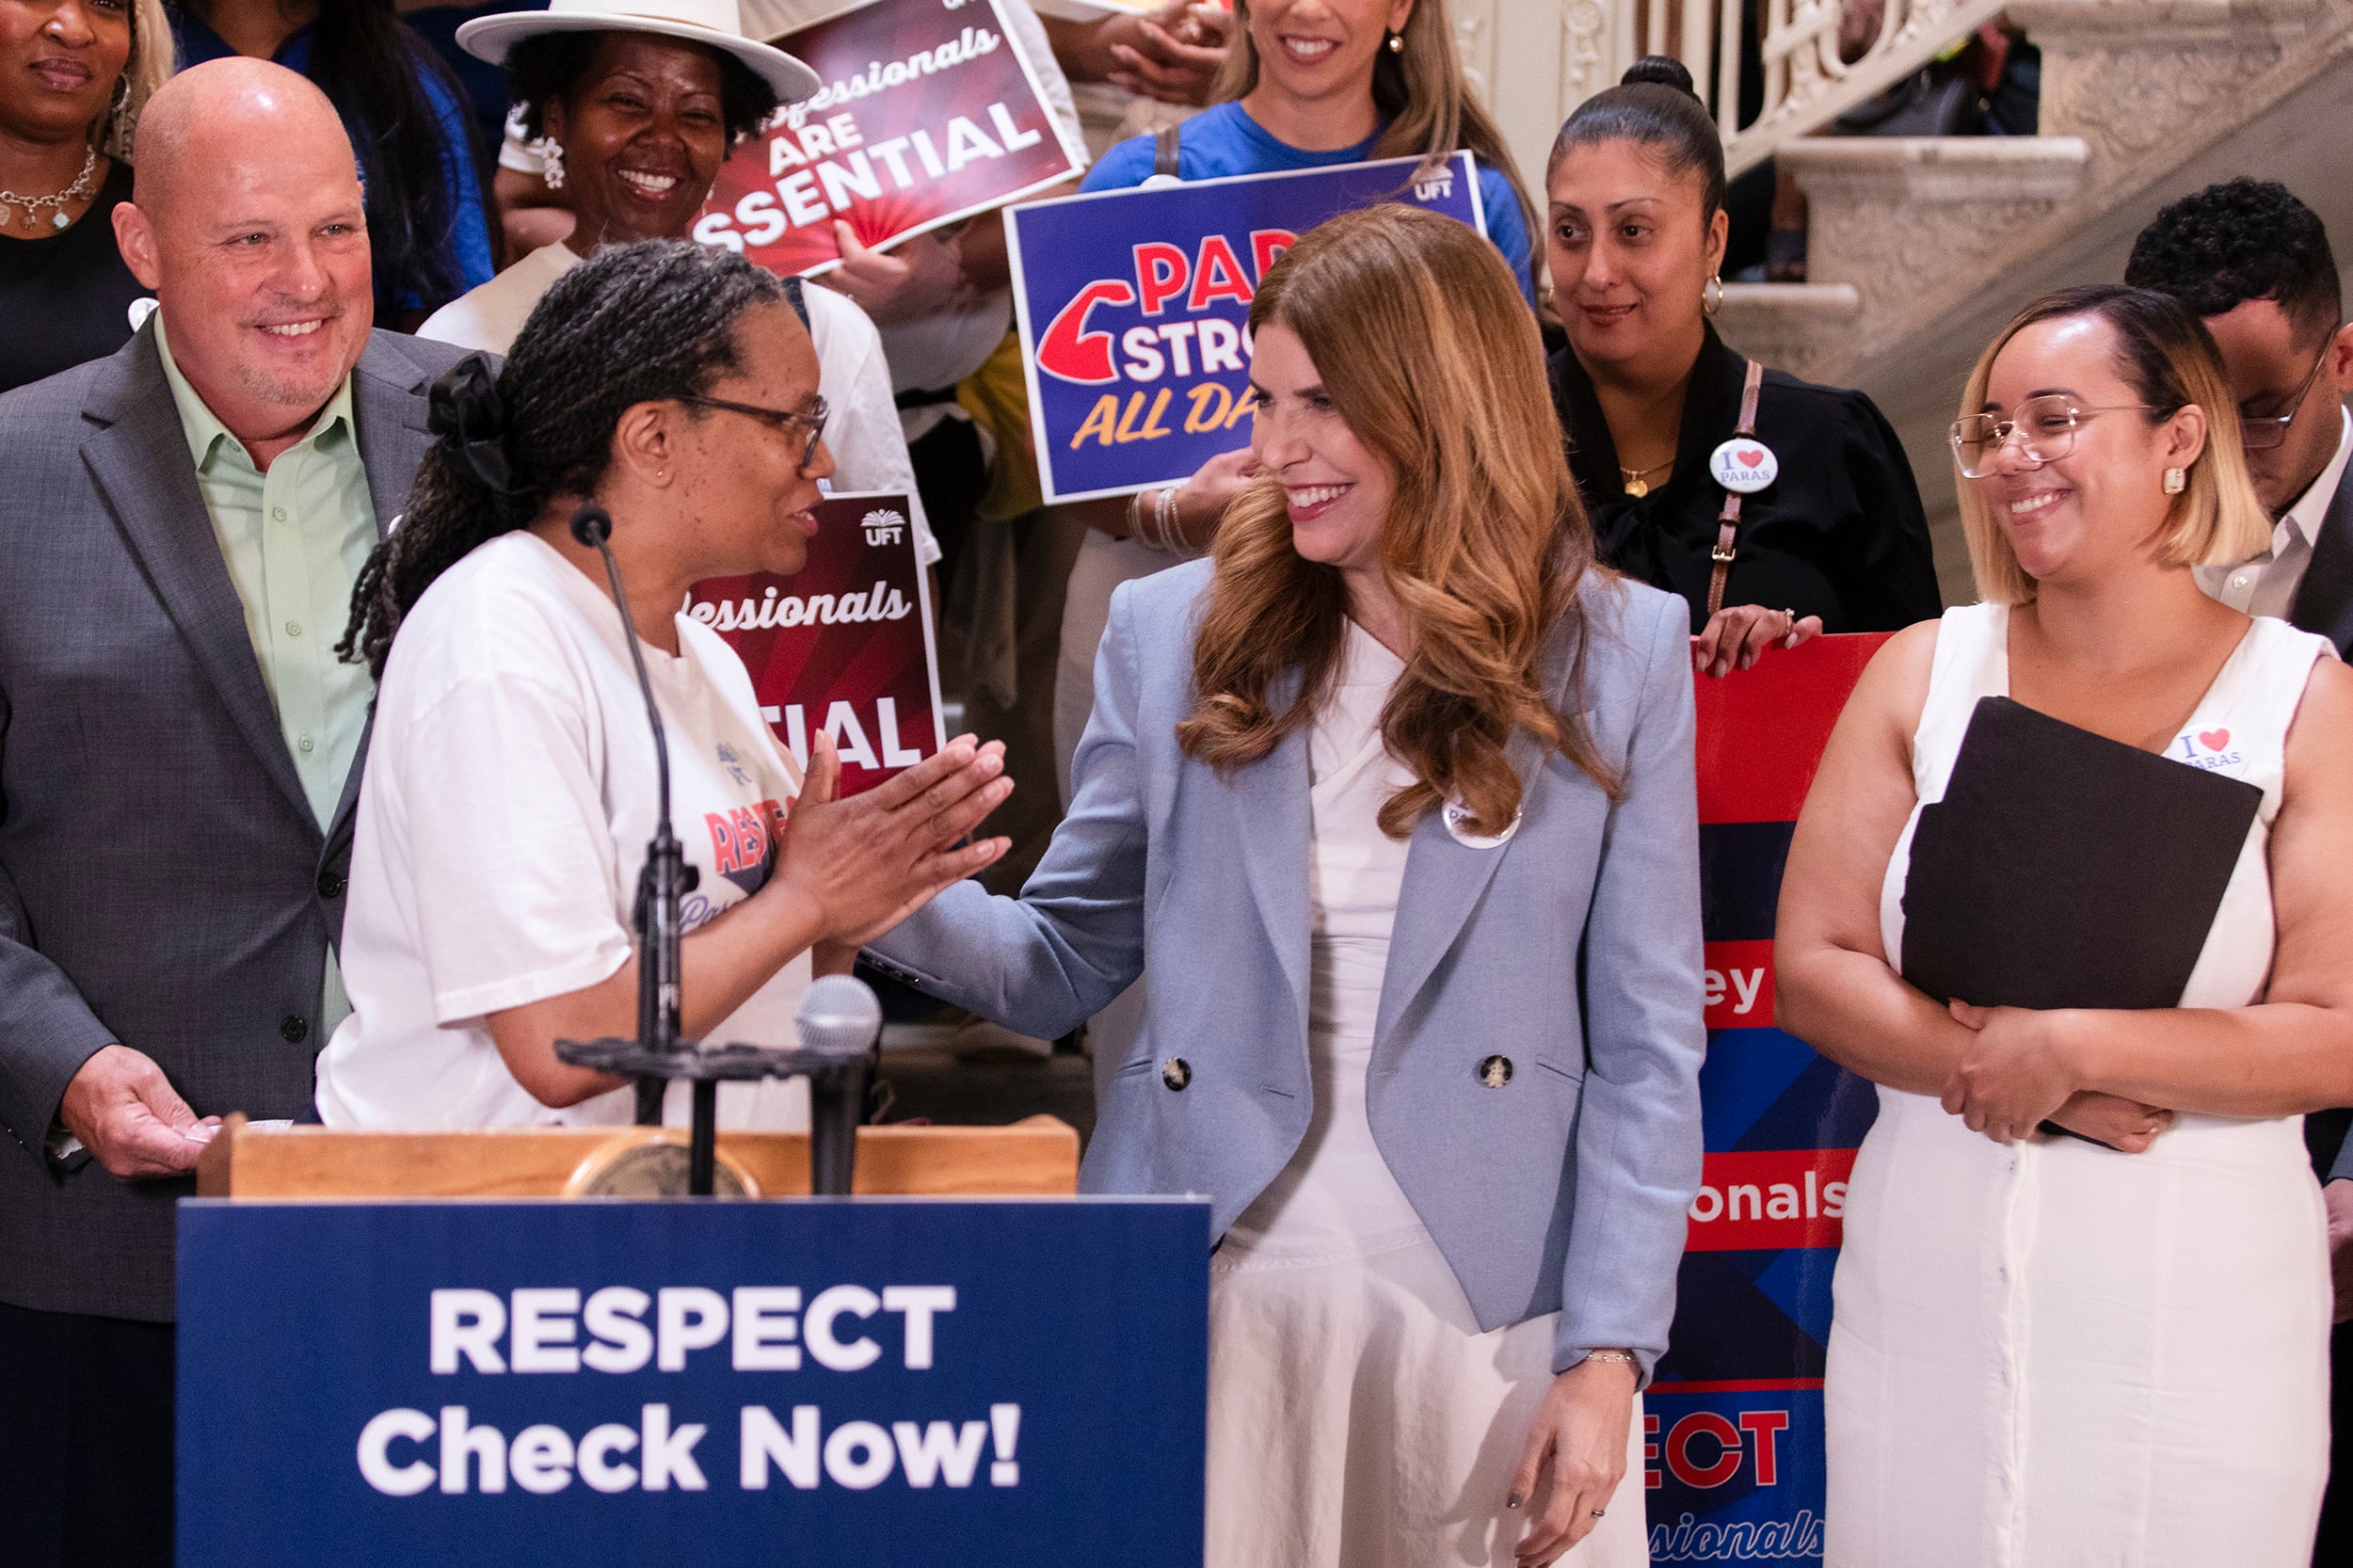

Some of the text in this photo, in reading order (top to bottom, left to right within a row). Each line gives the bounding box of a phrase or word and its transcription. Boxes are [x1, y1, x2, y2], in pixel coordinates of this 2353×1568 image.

[769, 112, 864, 177] ARE
[692, 102, 1042, 252] SSENTIAL
[1122, 318, 1255, 382] STR
[1070, 387, 1173, 450] ALL
[1721, 470, 1770, 483] PARAS
[1723, 451, 1734, 470] I
[865, 527, 903, 546] UFT
[680, 581, 912, 632] essionals
[2179, 734, 2198, 758] I
[1689, 1170, 1847, 1223] onals
[430, 1285, 956, 1373] RESPECT
[358, 1404, 1019, 1495] Check Now!
